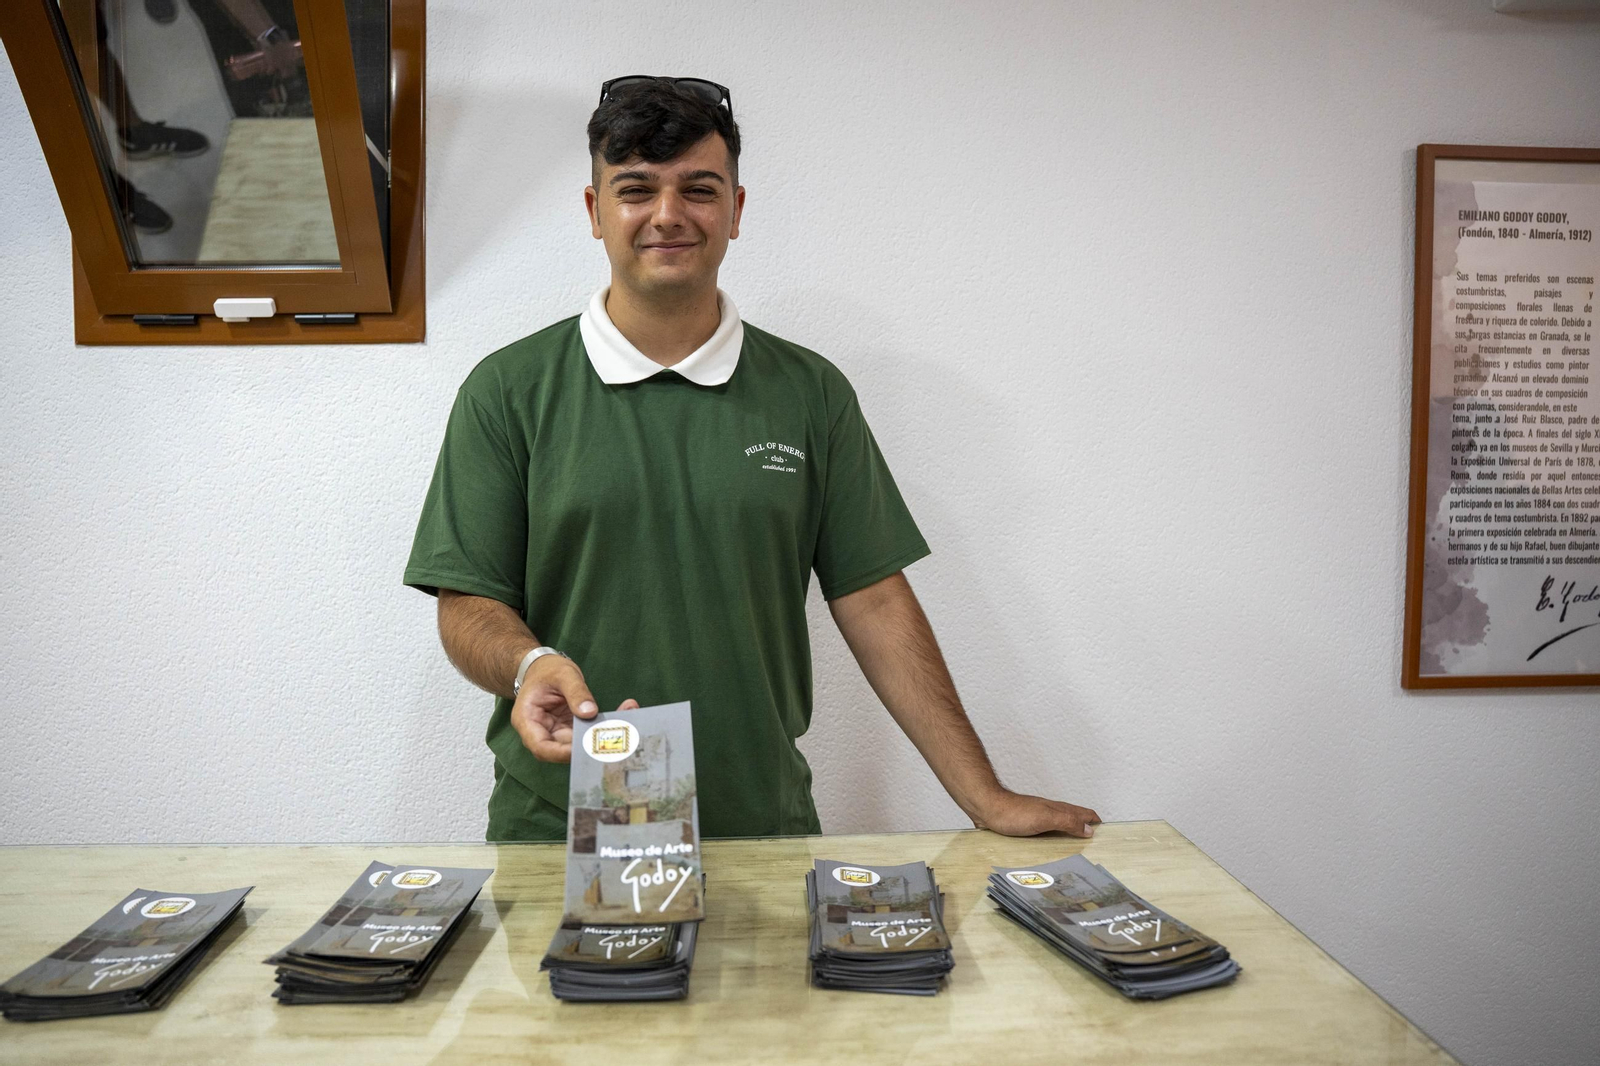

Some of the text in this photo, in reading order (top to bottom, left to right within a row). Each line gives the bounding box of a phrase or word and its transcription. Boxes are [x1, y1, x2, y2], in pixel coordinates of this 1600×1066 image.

[1458, 210, 1569, 225] EMILIANO GODOY GODOY,
[1458, 227, 1592, 242] (Fondón, 1840 Almería, 1912)
[1456, 272, 1469, 281] Sus
[1477, 273, 1497, 282] temas
[1505, 274, 1540, 284] preferidos
[1567, 276, 1594, 284] escenas
[1456, 286, 1562, 299] costumbristas, paisajes
[1456, 302, 1592, 313] composiciones florales llenas de
[1455, 315, 1585, 327] frescura riqueza de colorido. Debido
[1540, 332, 1570, 342] Granada,
[1584, 332, 1591, 341] le
[1455, 345, 1468, 353] cita
[1479, 345, 1532, 354] frecuentemente
[1562, 346, 1590, 355] diversas
[1454, 358, 1589, 371] publicaciones estudios como pintor
[1492, 372, 1588, 384] Alcanzó un elevado dominio
[1453, 387, 1478, 397] técnico
[1506, 388, 1532, 398] cuadros
[1535, 388, 1543, 398] de
[1546, 387, 1588, 400] composición
[1452, 401, 1577, 413] con palomas, considerandole, en este
[1452, 414, 1600, 426] tema, junto José Ruiz Blasco, padre de
[1452, 428, 1591, 440] pintores de la época. finales del siglo
[745, 444, 765, 456] FULL
[778, 444, 805, 462] ENERG
[1452, 442, 1478, 453] colgaba
[1480, 445, 1488, 453] ya
[1490, 444, 1498, 452] en
[1501, 443, 1510, 452] los
[1540, 443, 1548, 452] de
[1550, 443, 1572, 452] Sevilla
[771, 455, 784, 463] club
[1451, 457, 1595, 468] la Exposición Universal de París de 1878,
[1451, 471, 1566, 482] Roma, donde residía por aquel
[1450, 485, 1582, 496] exposiciones nacionales de Bellas Artes
[1450, 499, 1492, 510] participando
[1504, 499, 1514, 508] los
[1516, 500, 1531, 508] años
[1533, 499, 1551, 508] 1884
[1567, 499, 1578, 508] dos
[1455, 513, 1588, 523] cuadros de tema costumbrista. En 1892
[1449, 527, 1597, 539] la primera exposición celebrada en Almería.
[1448, 541, 1599, 552] hermanos de su hijo Rafael, buen dibujante
[1448, 556, 1468, 565] estela
[1470, 555, 1498, 565] artística
[1510, 555, 1544, 565] transmitió
[600, 843, 693, 858] Museo de Arte
[620, 858, 693, 913] Godoy
[1079, 917, 1114, 927] Museo
[1127, 910, 1150, 920] Arte
[584, 926, 620, 934] Museo
[622, 926, 638, 934] de
[1108, 918, 1161, 946] Godoy
[369, 930, 433, 954] Godoy
[870, 925, 932, 948] Godoy
[598, 934, 663, 960] Godoy
[88, 962, 163, 990] Godoy
